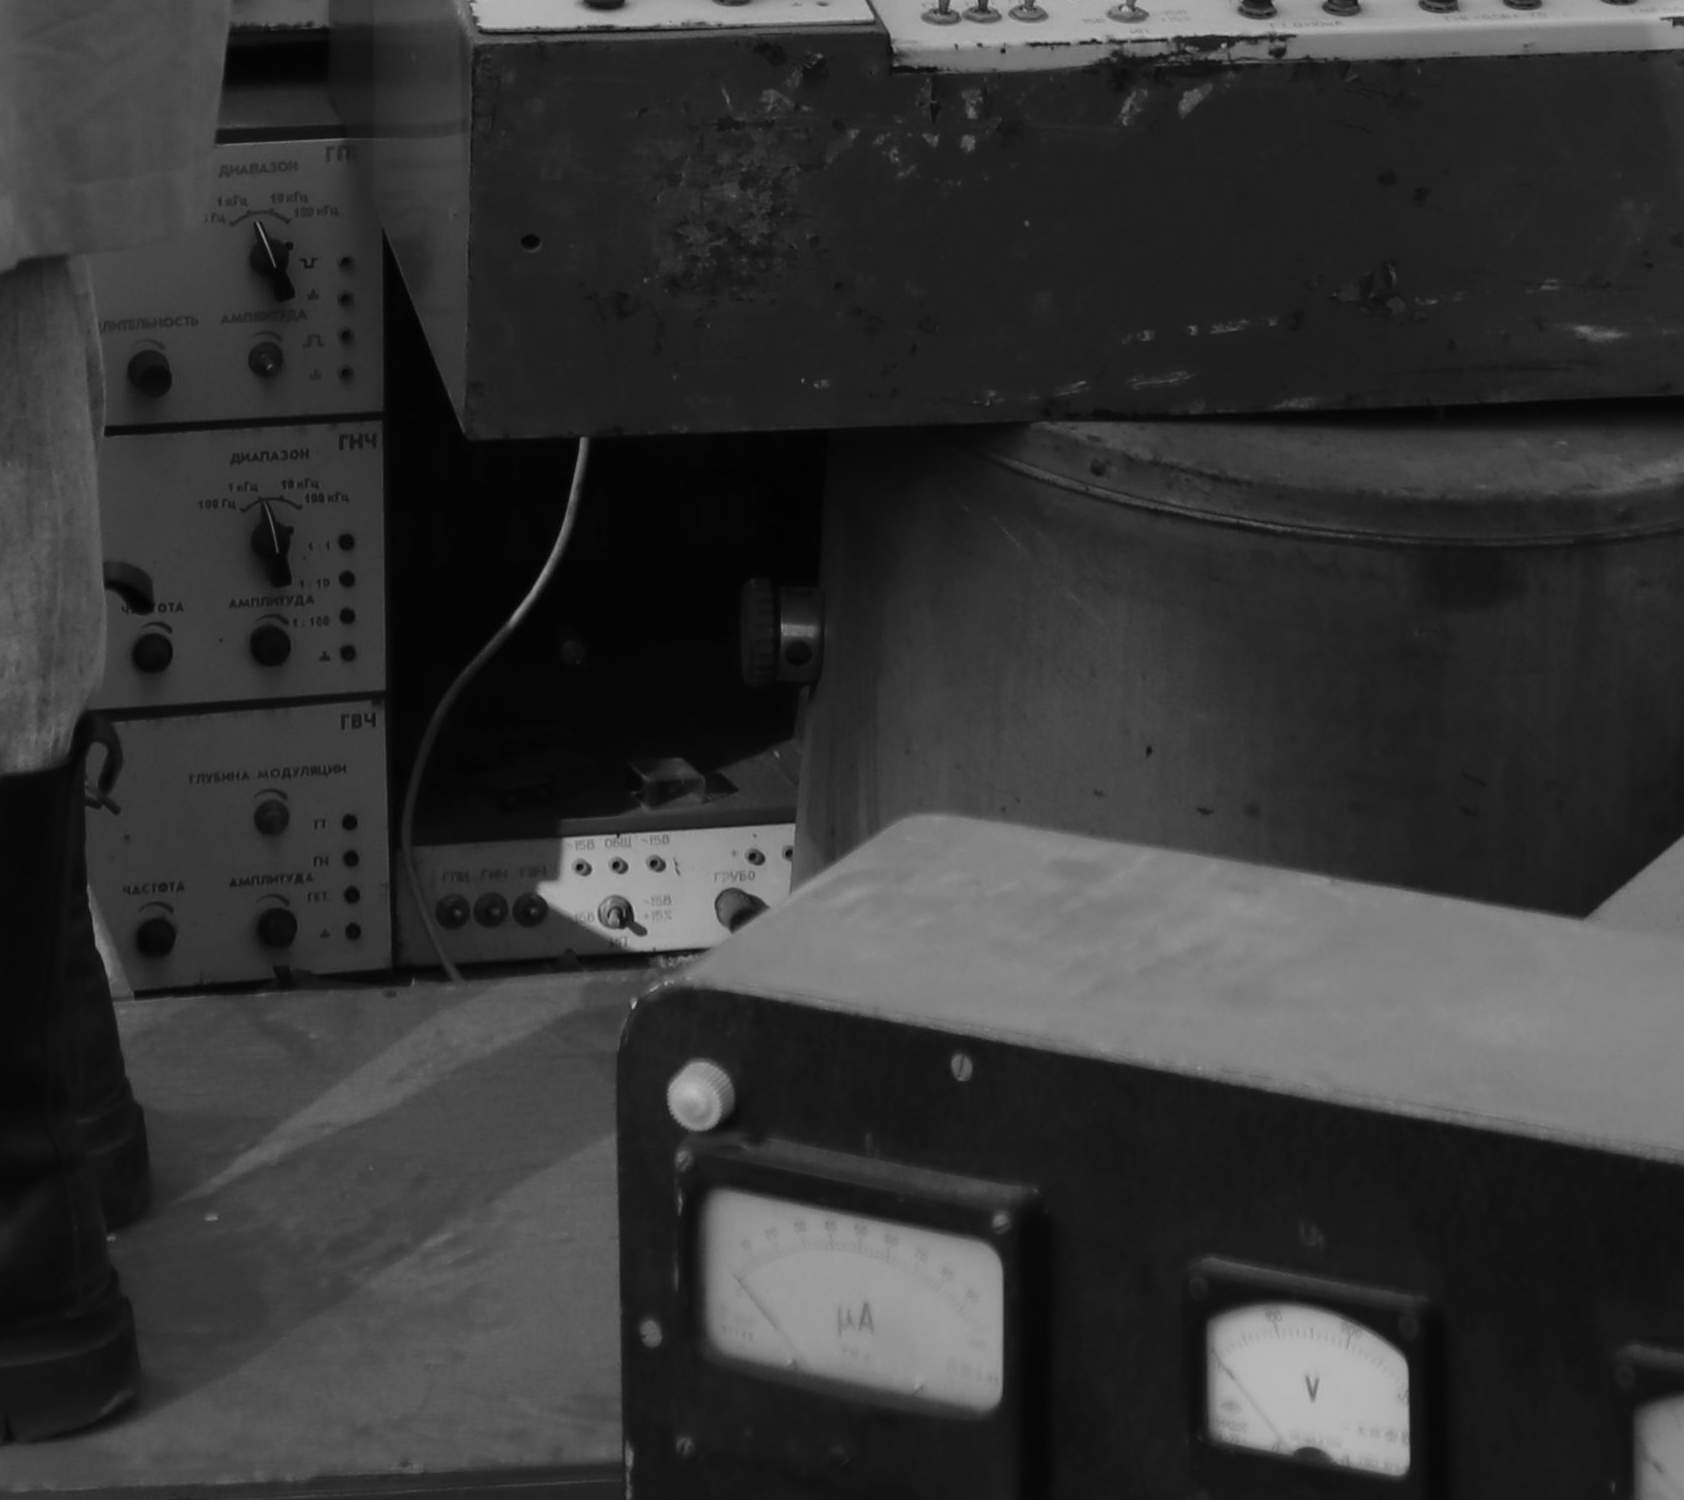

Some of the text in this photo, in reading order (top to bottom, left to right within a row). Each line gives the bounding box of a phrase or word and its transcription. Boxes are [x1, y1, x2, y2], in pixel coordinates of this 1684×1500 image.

[218, 160, 298, 178] ДИАПАЗОН
[220, 308, 308, 324] АМПЛИТУДА
[338, 432, 378, 451] ГНЧ
[229, 448, 310, 466] ДИАПАЗОН
[228, 594, 315, 610] АМПЛИТУДА
[339, 712, 377, 731] ГВЧ
[188, 763, 348, 786] ГЛУБИНА МОДУЛЯЦИИ
[228, 872, 314, 889] АМПЛИТУДА
[714, 871, 756, 882] ГРУБО
[122, 881, 186, 896] ЧАСТОТА
[1304, 1373, 1321, 1404] V
